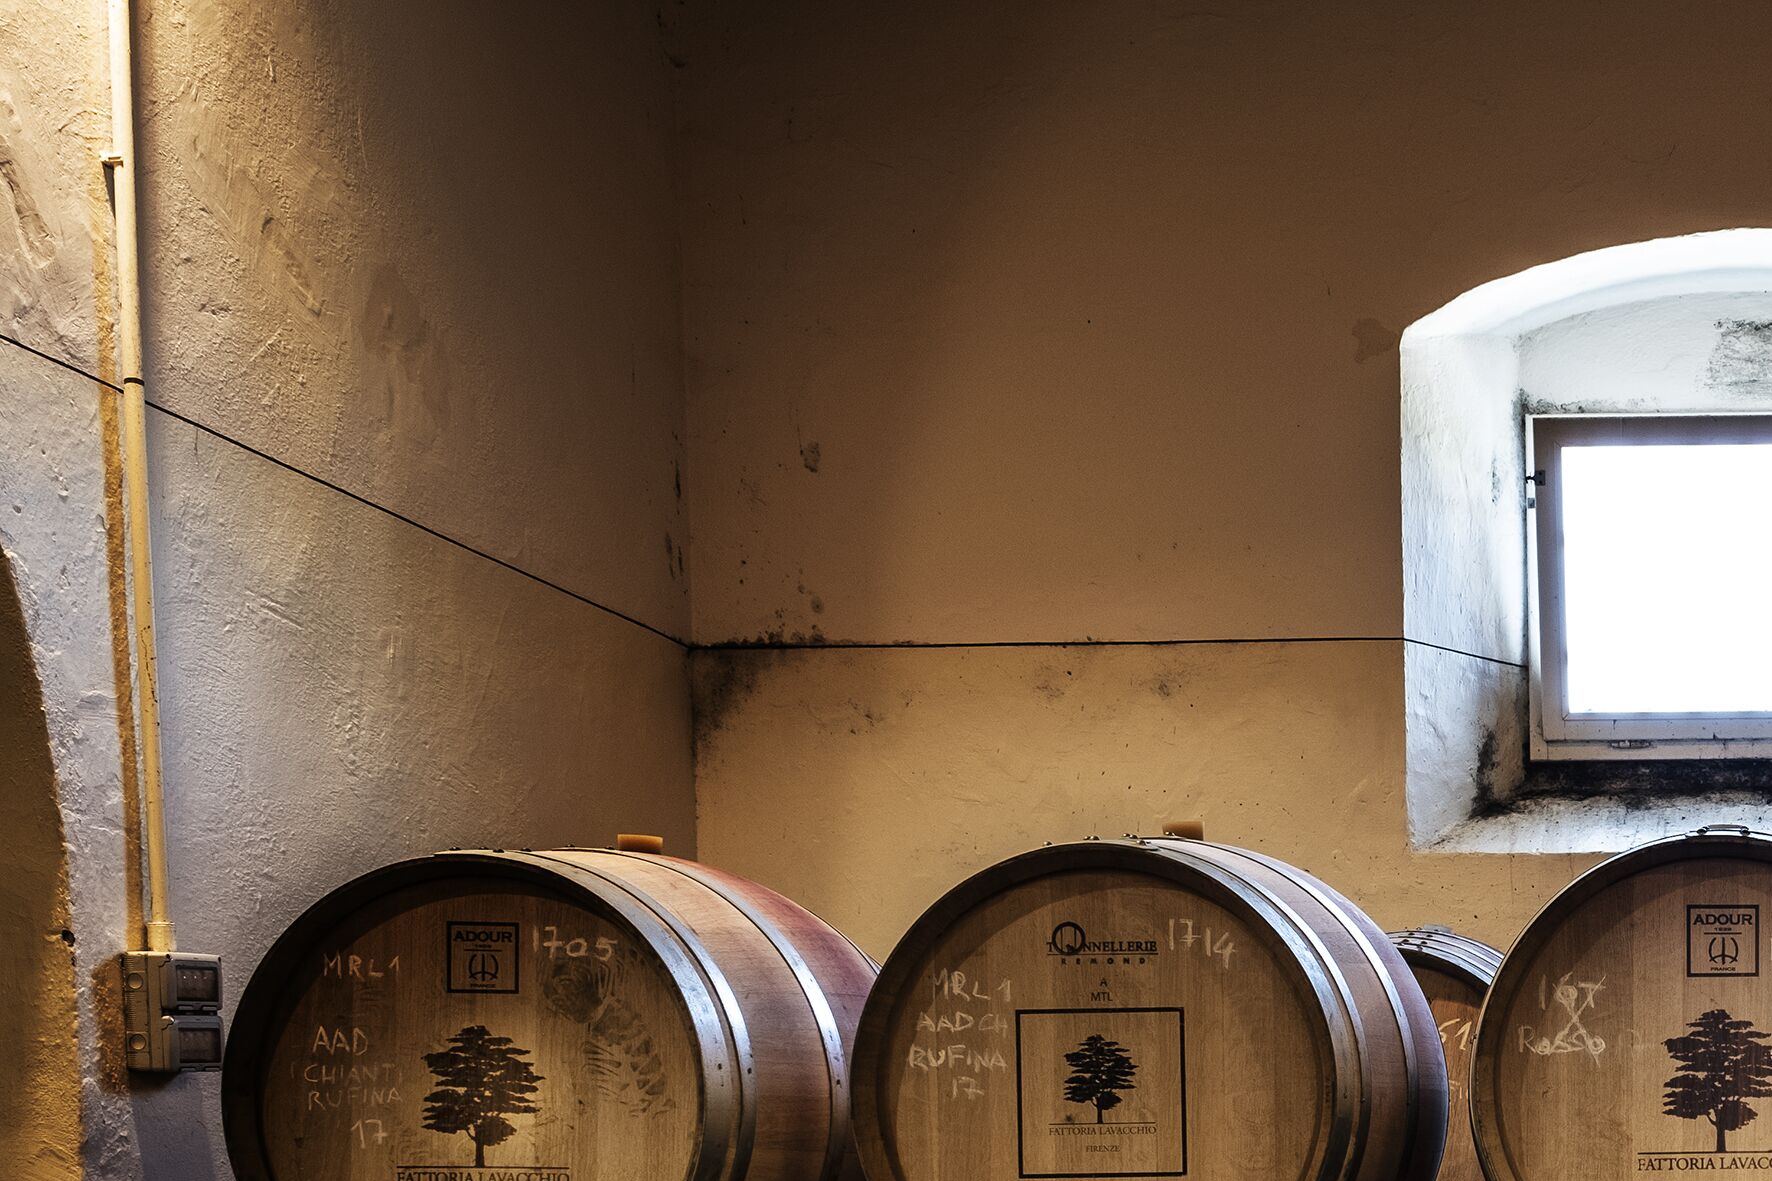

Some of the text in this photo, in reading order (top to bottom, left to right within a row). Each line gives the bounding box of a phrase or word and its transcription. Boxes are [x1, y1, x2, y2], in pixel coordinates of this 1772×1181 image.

[1693, 914, 1752, 925] ADOUR
[453, 930, 513, 943] ADOUR
[533, 926, 618, 961] 1705
[1046, 921, 1157, 955] TONNELLERIE
[1168, 918, 1239, 970] 1714
[1090, 991, 1113, 1001] MTL
[917, 1011, 973, 1033] AAD
[312, 1026, 369, 1056] AAD
[908, 1044, 1008, 1073] RUFINA
[308, 1087, 403, 1111] RUFINA
[951, 1076, 985, 1100] 17
[351, 1119, 388, 1149] 17
[1049, 1125, 1157, 1136] FATTORIA LAVACCHIO
[1085, 1144, 1120, 1153] FIRENZE
[1637, 1158, 1716, 1171] FATTORIA
